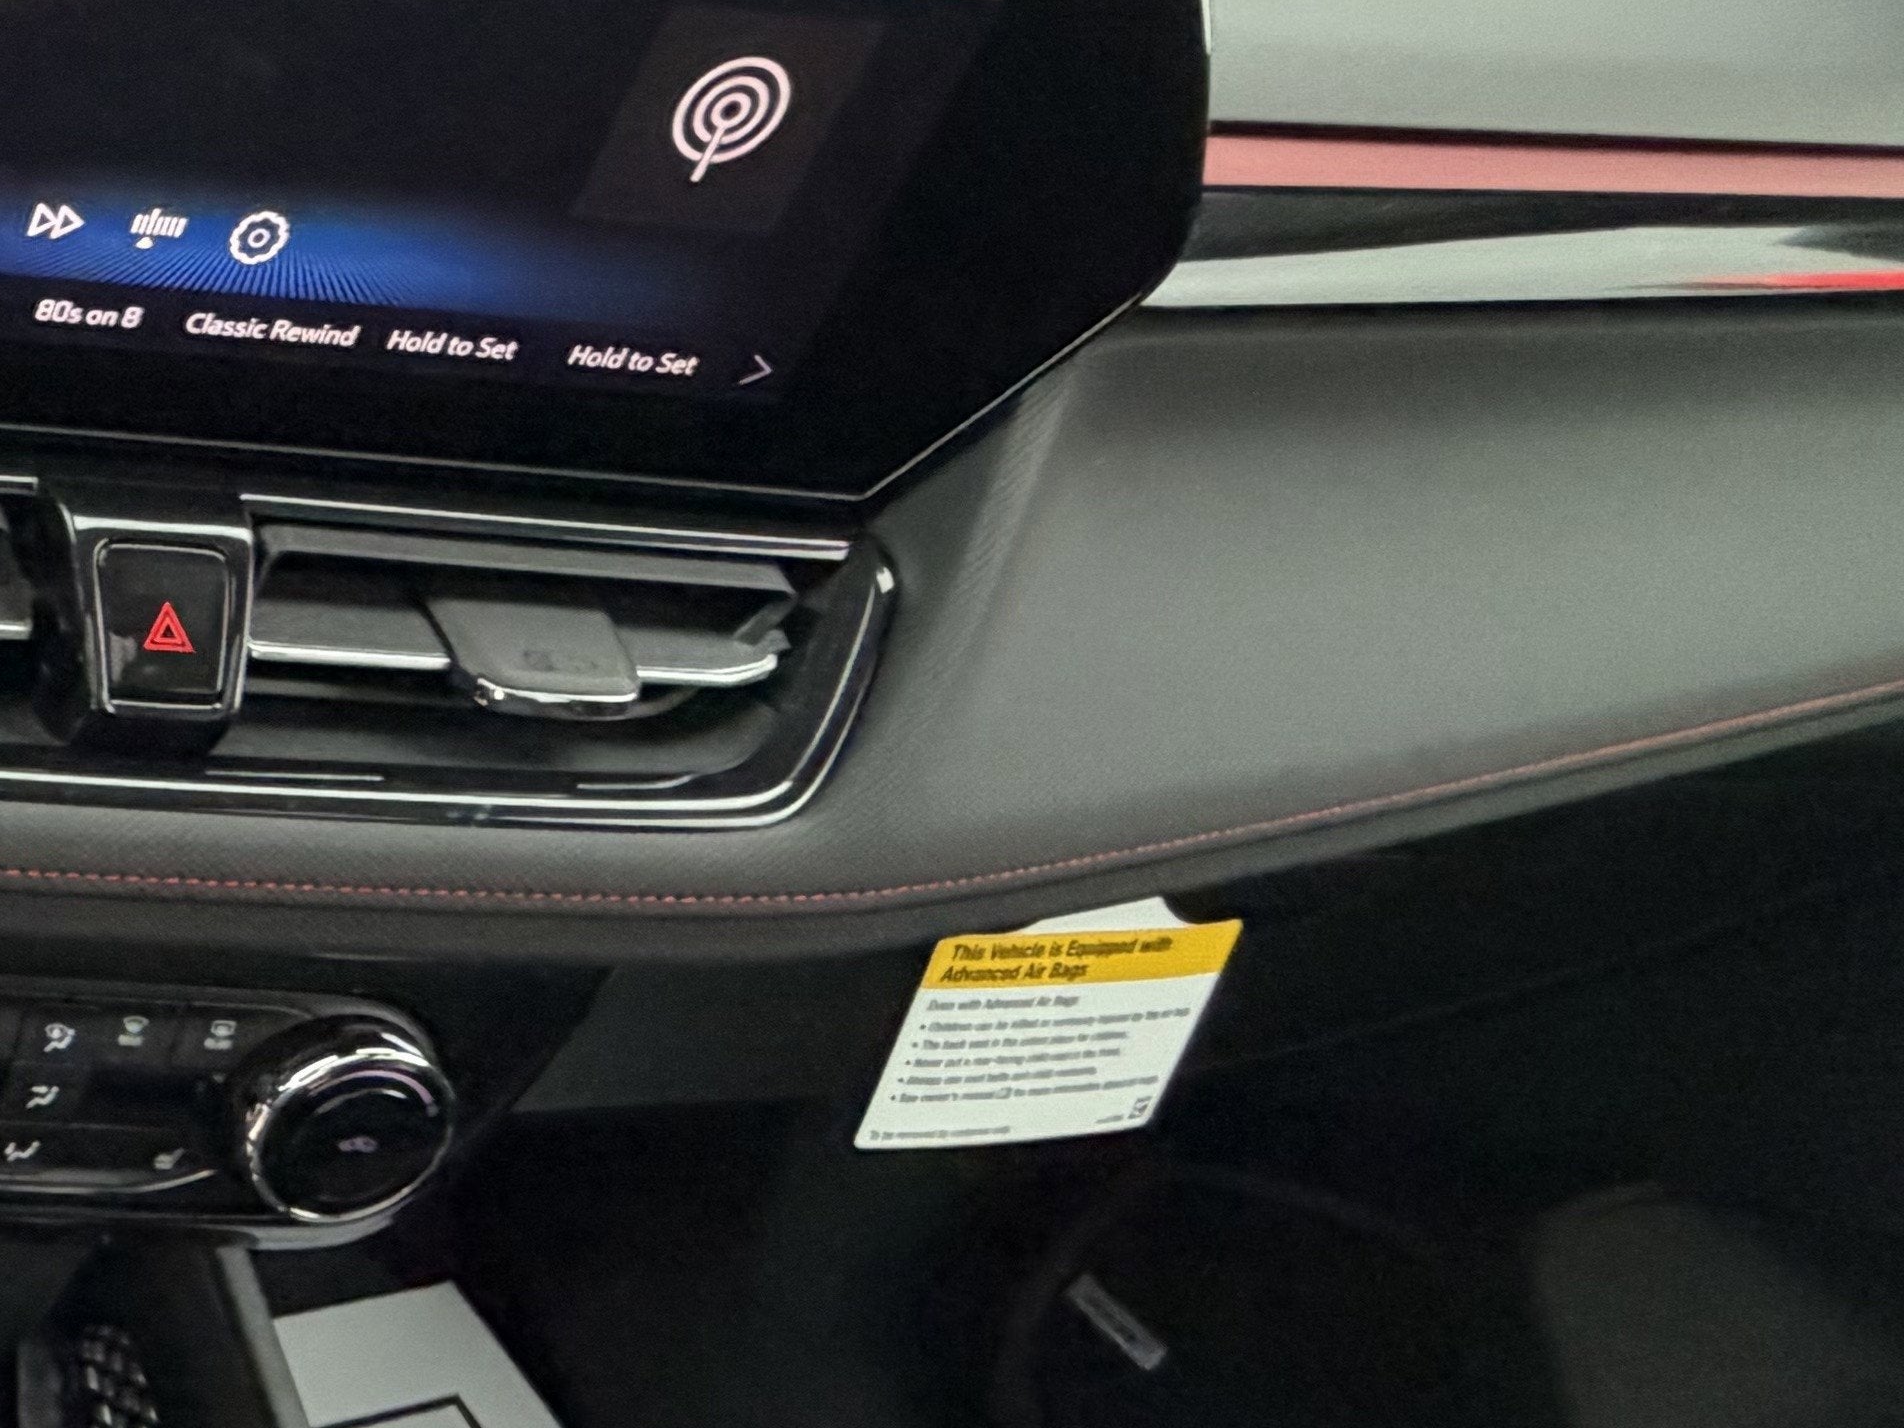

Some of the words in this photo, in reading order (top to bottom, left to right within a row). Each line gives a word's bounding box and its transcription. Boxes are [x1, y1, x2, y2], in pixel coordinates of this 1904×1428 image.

[35, 298, 81, 324] 80s
[86, 309, 115, 327] on
[121, 305, 144, 329] 8
[185, 313, 268, 340] Classic
[269, 319, 361, 348] Rewind
[385, 329, 446, 356] Hold
[448, 335, 472, 357] to
[474, 337, 518, 361] Set
[567, 345, 627, 371] Hold
[628, 350, 652, 373] to
[655, 352, 700, 377] Set
[953, 944, 985, 961] This
[991, 943, 1045, 961] Vehicle
[1048, 941, 1063, 957] is
[1139, 937, 1173, 953] with
[940, 965, 1021, 983] Advanced
[1023, 963, 1046, 979] Air
[1048, 962, 1089, 982] Bags
